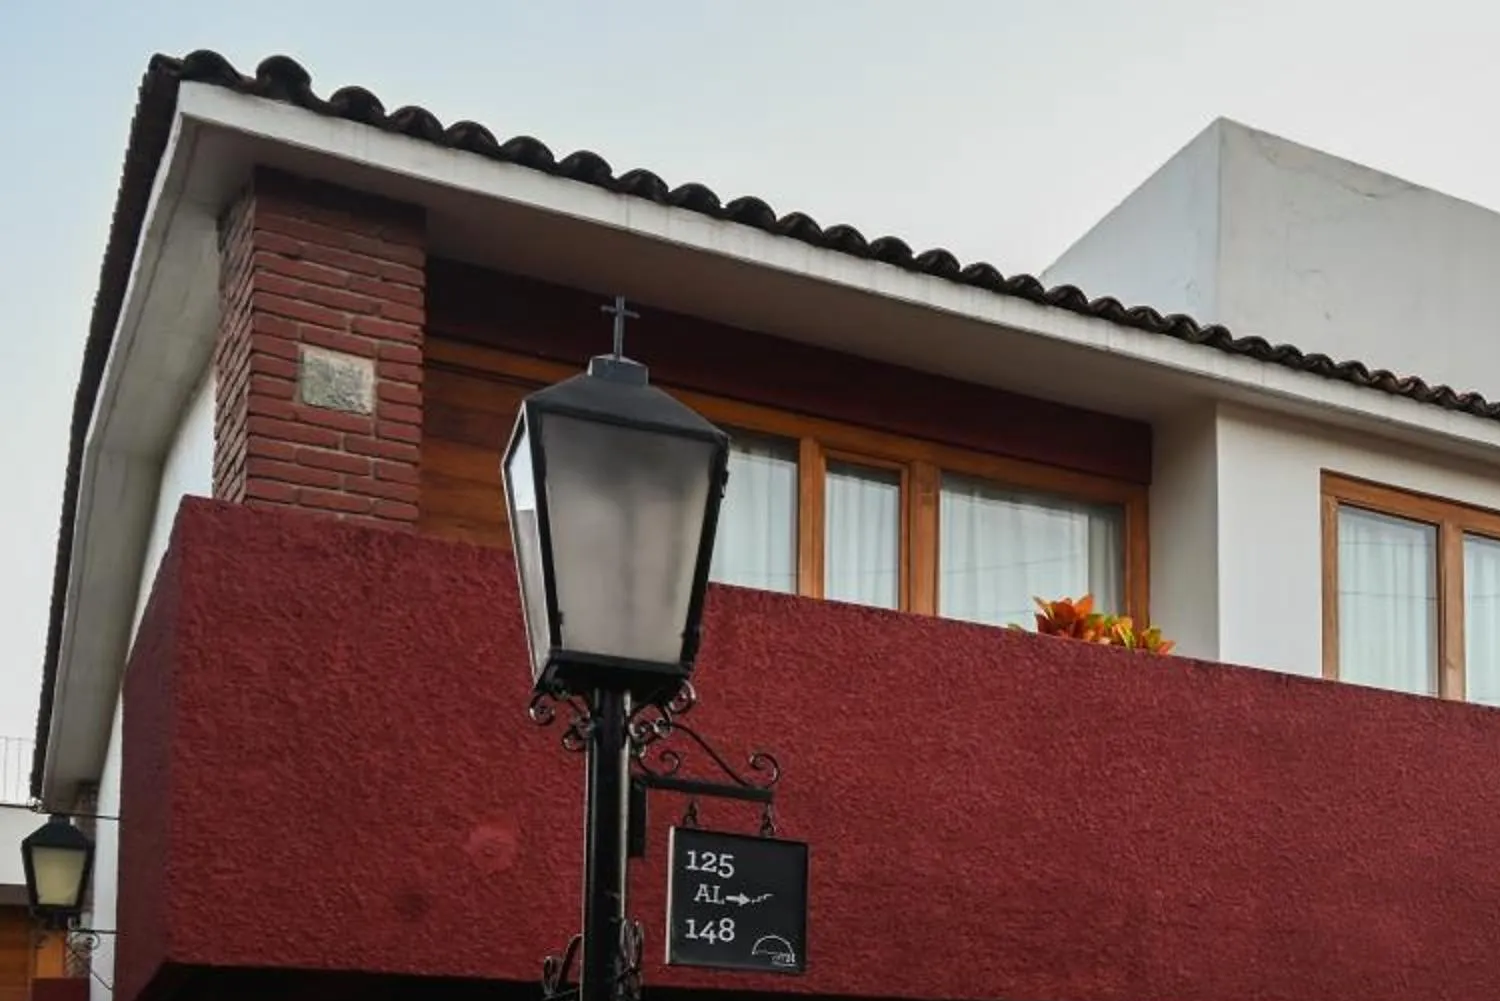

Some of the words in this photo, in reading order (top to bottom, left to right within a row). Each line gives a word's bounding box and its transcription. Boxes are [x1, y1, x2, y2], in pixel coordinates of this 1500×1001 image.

[686, 850, 735, 878] 125
[694, 883, 725, 905] AL
[685, 918, 735, 944] 148
